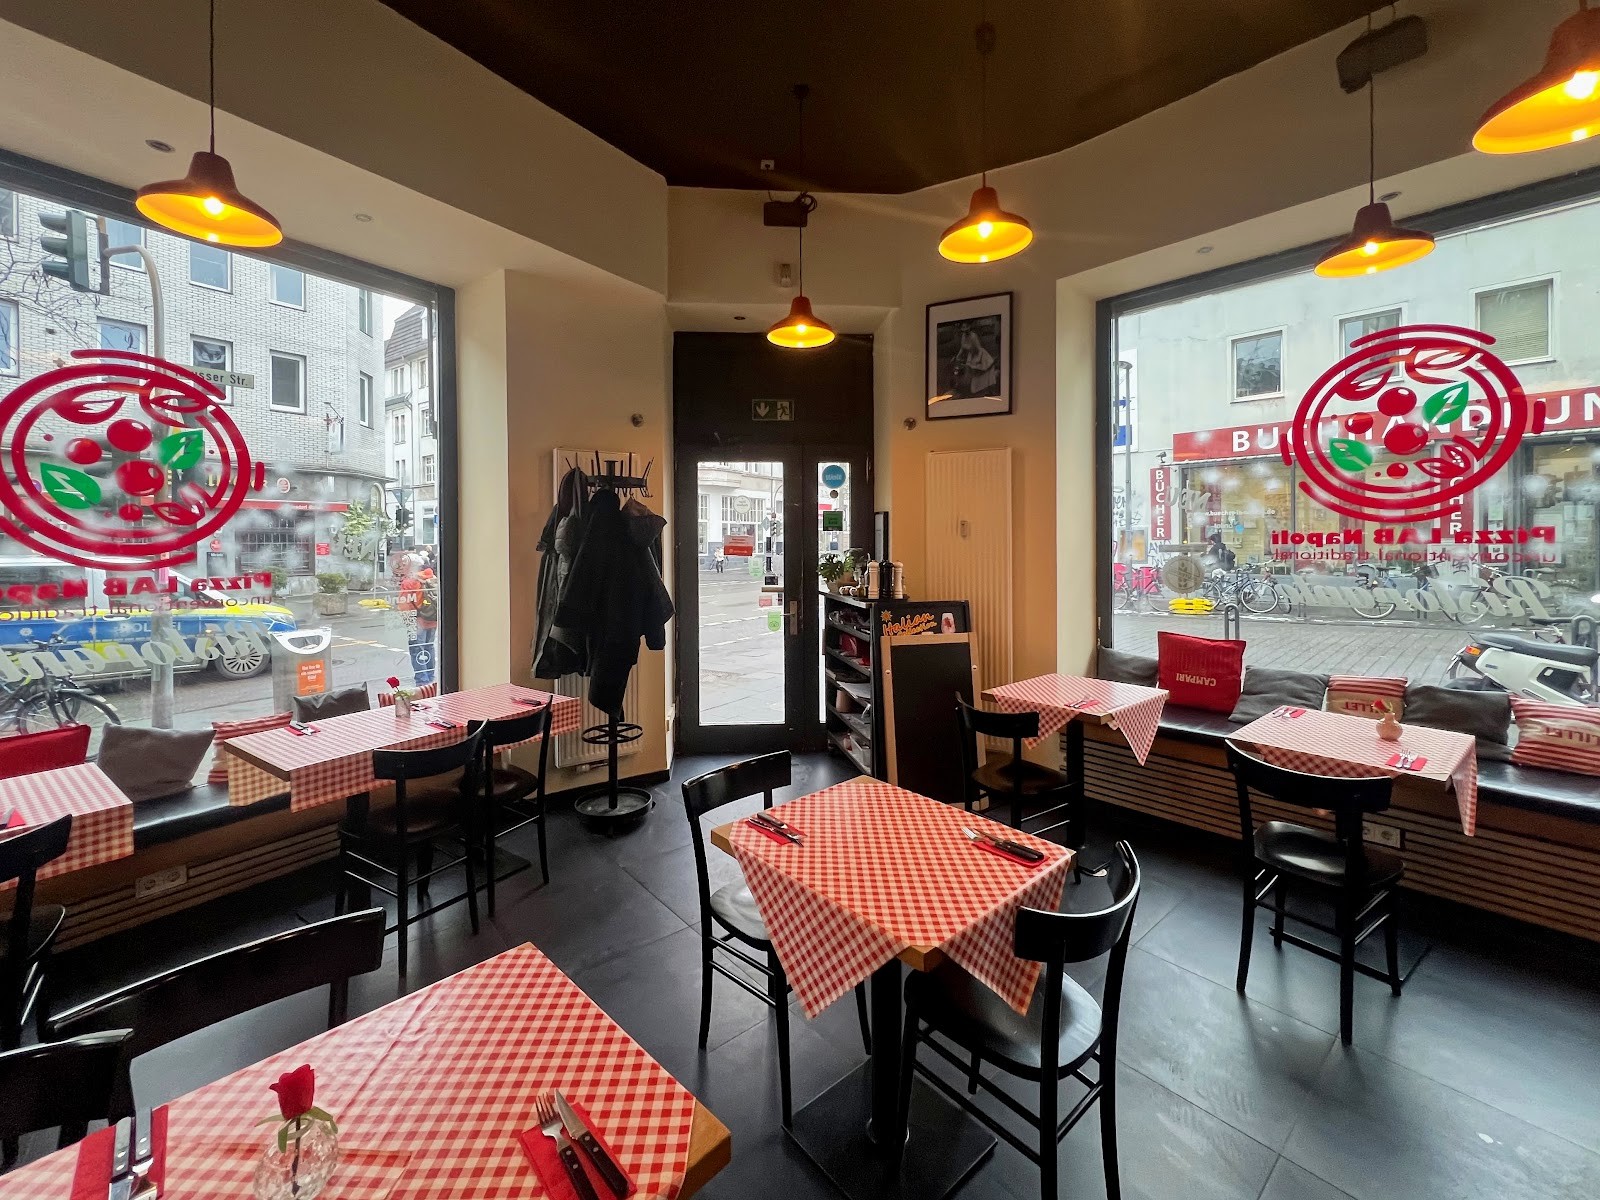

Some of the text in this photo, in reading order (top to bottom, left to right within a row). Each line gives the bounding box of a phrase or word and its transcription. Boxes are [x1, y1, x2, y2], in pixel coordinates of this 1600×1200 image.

[229, 374, 248, 386] Str.
[1155, 469, 1166, 538] BÜCHER
[1175, 672, 1218, 687] CAMPARI
